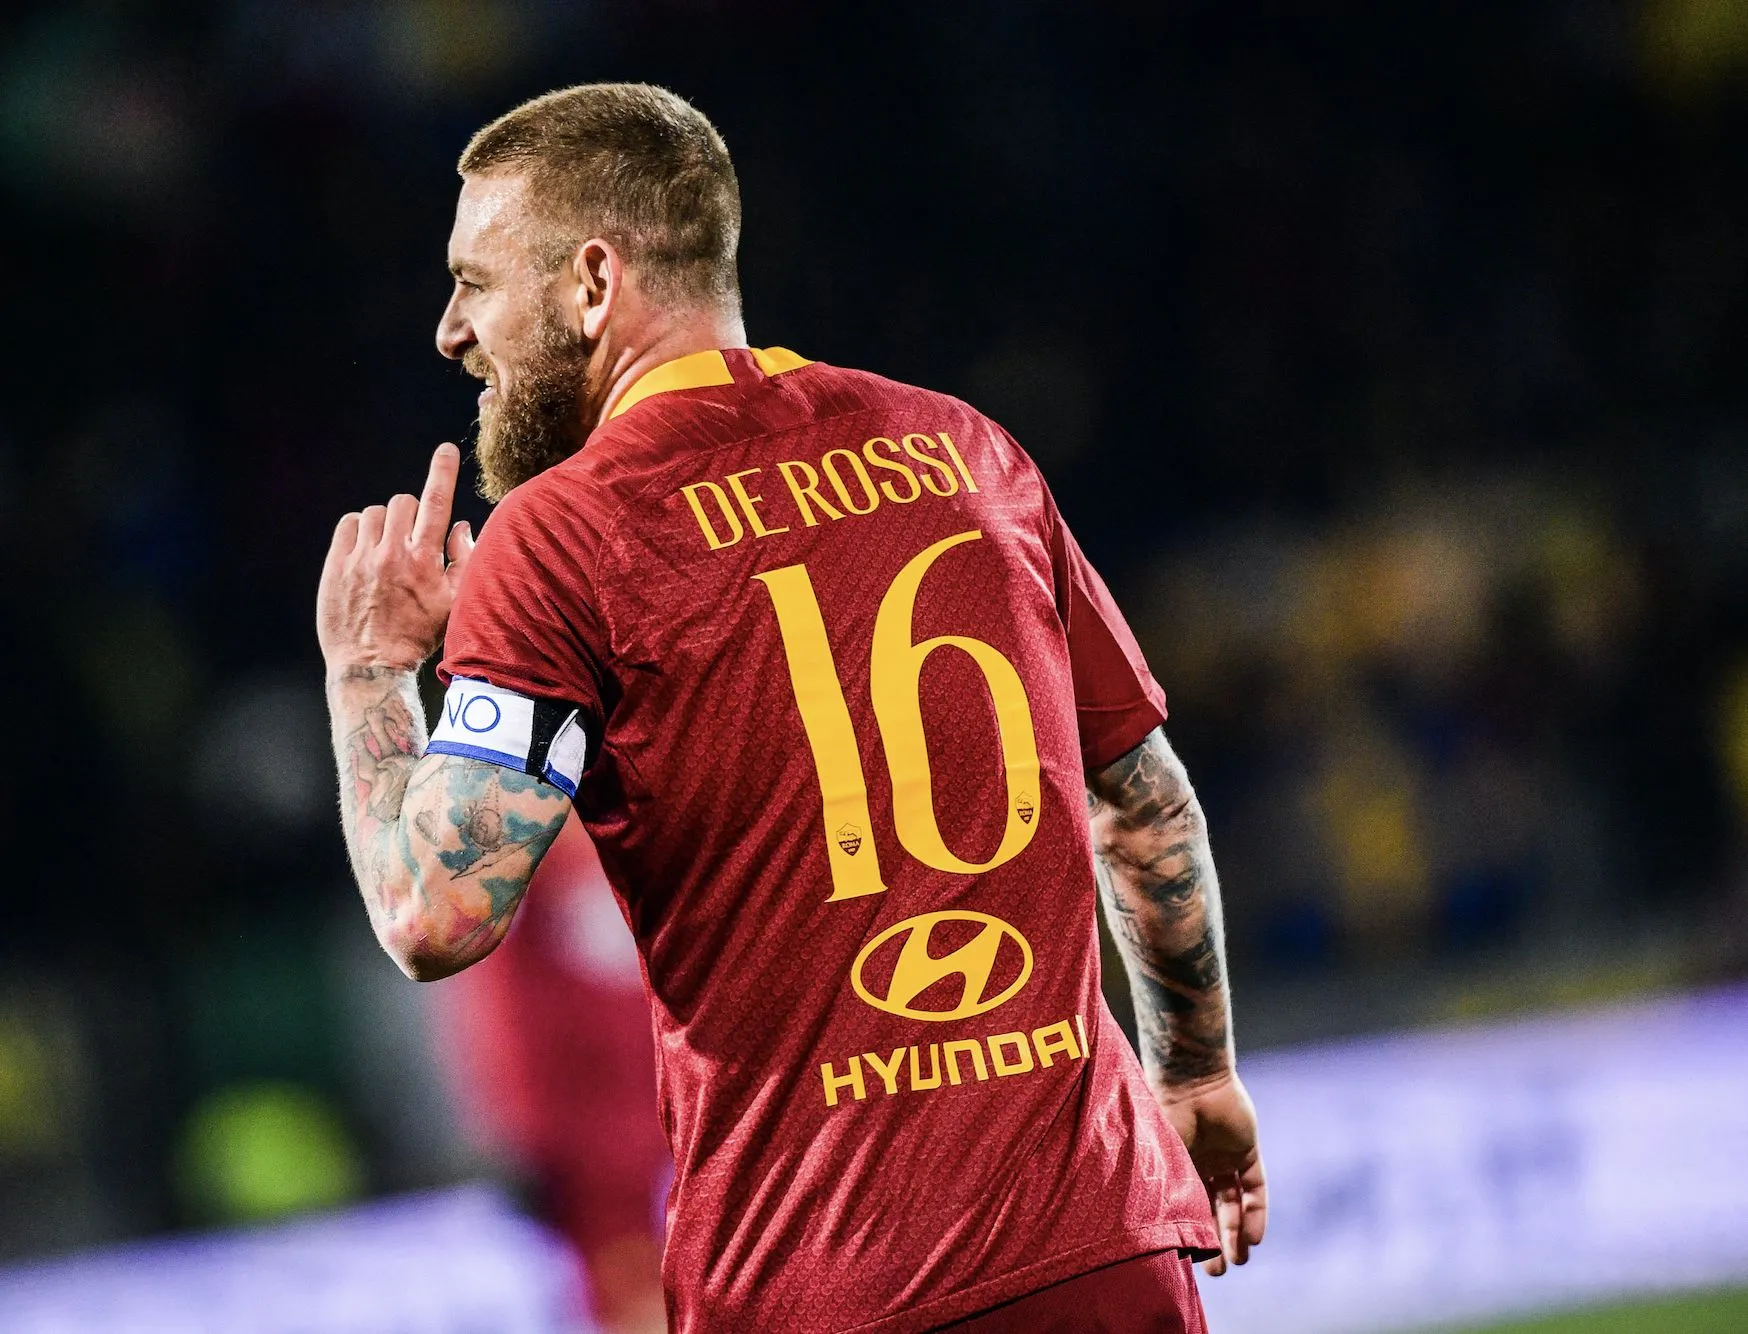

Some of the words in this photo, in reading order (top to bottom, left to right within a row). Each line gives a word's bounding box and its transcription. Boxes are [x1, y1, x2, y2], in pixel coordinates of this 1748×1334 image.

[681, 468, 790, 551] DE
[776, 432, 979, 527] ROSSI
[751, 529, 1041, 903] 16
[820, 1014, 1091, 1106] HYUNDAI
